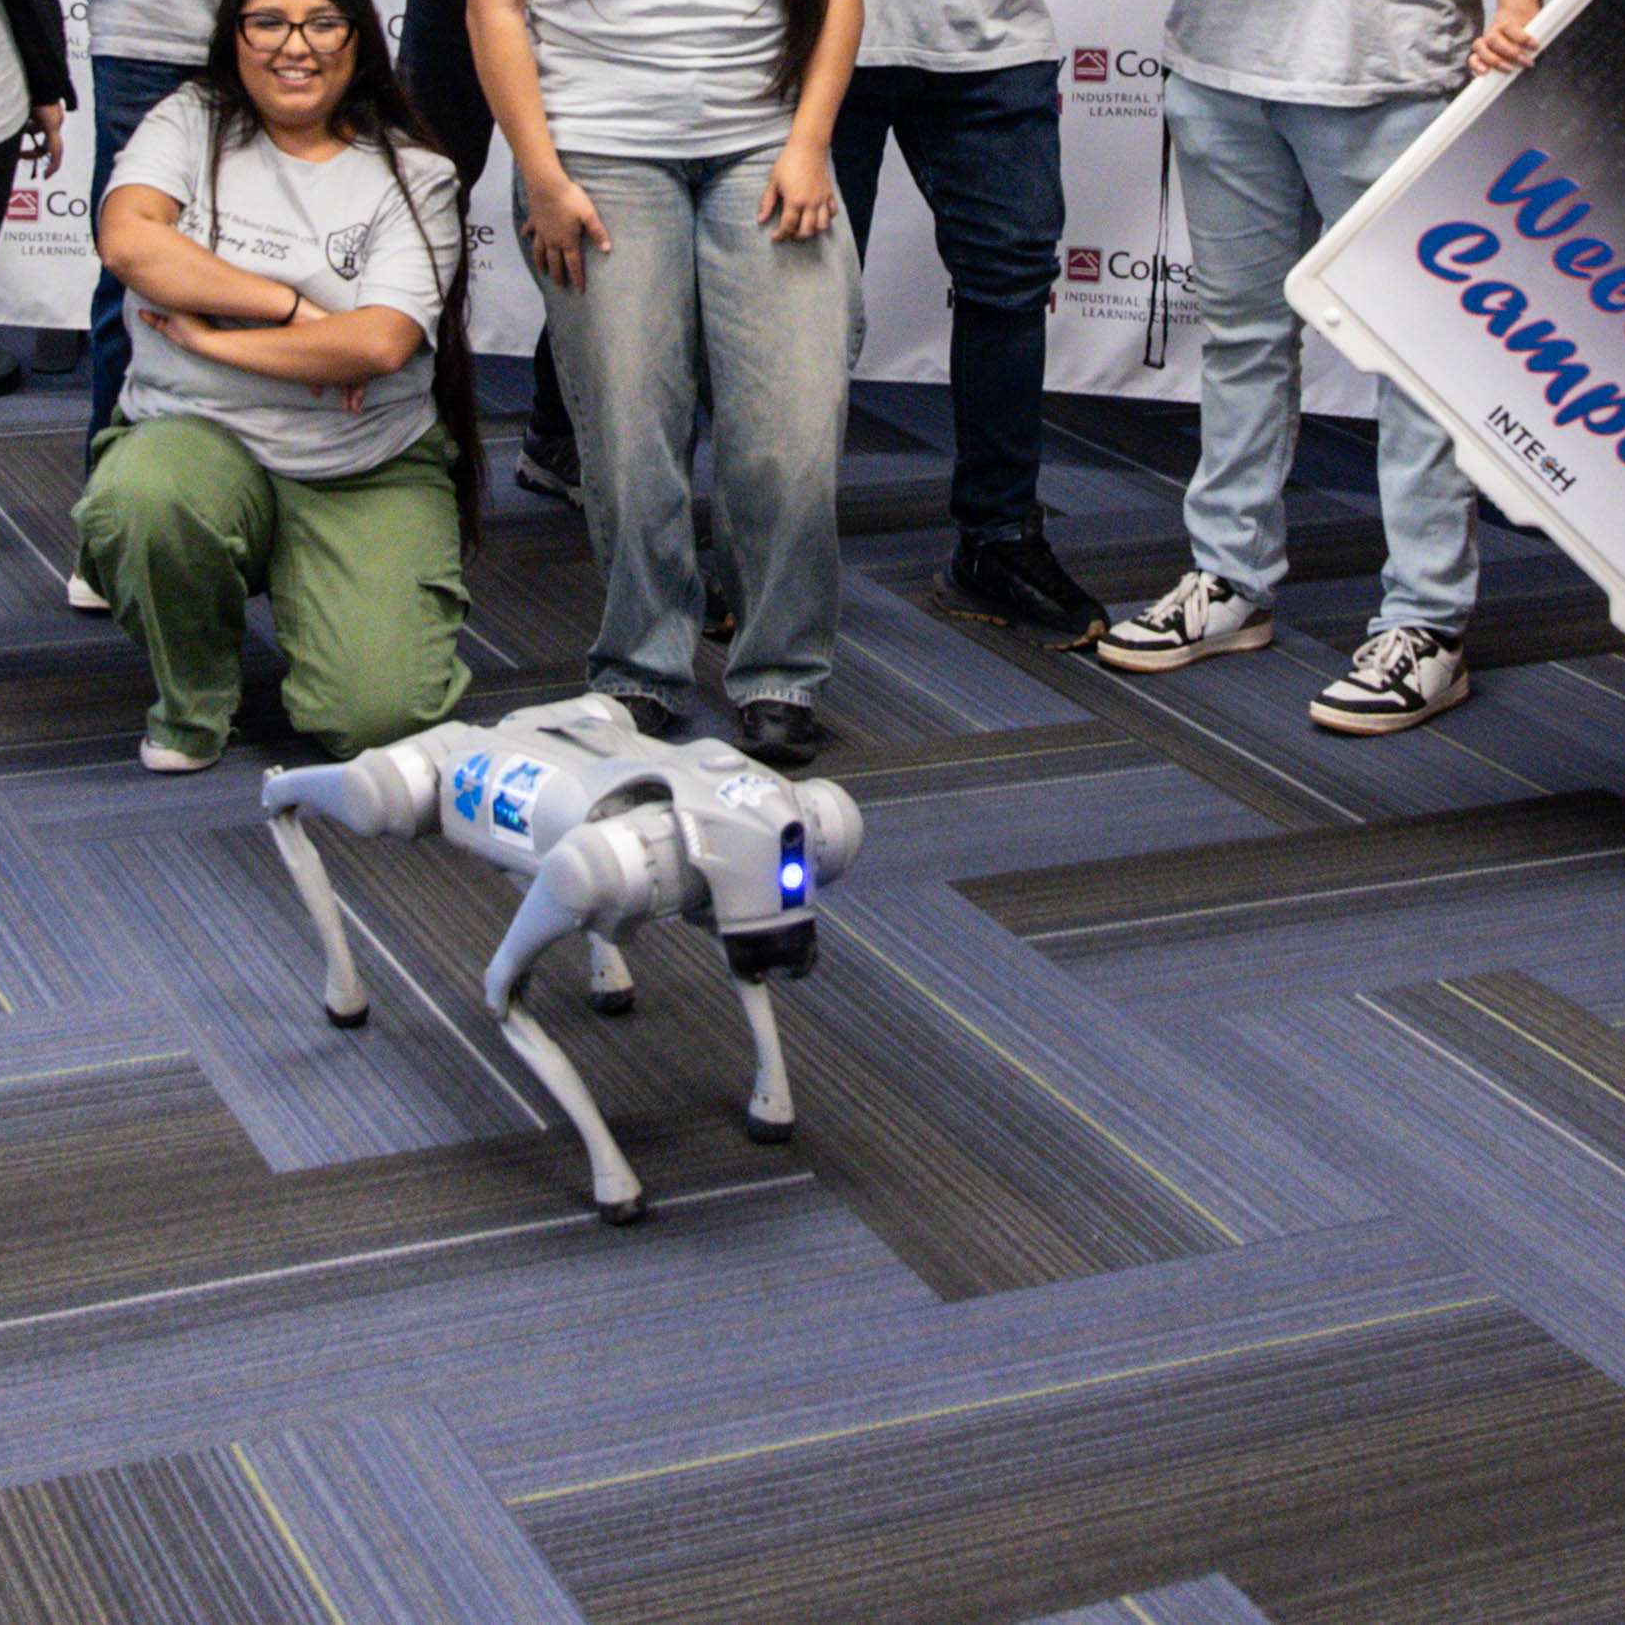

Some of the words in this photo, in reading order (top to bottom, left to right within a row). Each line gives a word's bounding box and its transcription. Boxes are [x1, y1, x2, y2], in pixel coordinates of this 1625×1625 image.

[1072, 97, 1150, 108] INDUSTRIAL
[1089, 111, 1158, 123] LEARNING
[4, 232, 77, 244] INDUSTRIAL
[22, 246, 86, 256] LEARNING
[251, 236, 290, 260] 2025
[1064, 292, 1139, 306] INDUSTRIAL
[1082, 307, 1147, 322] LEARNING
